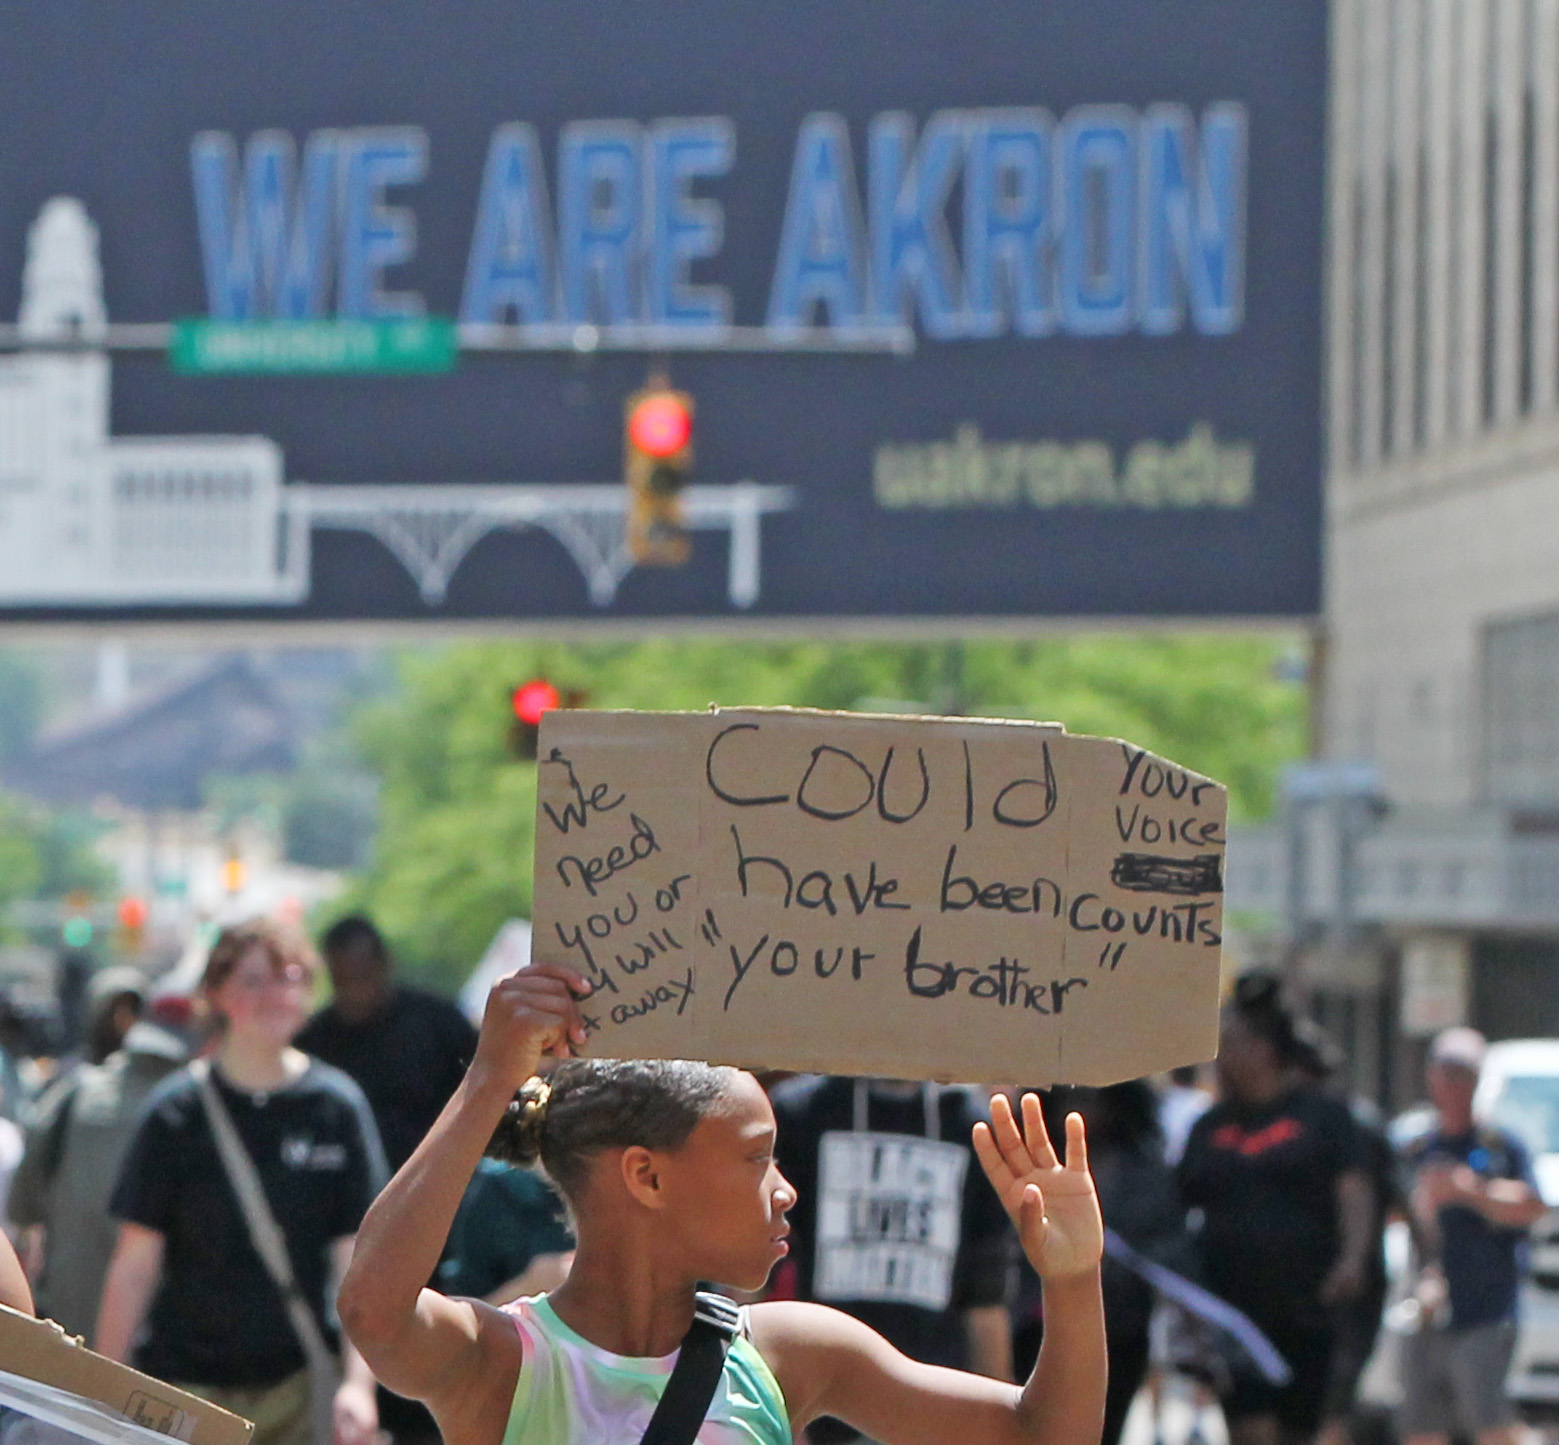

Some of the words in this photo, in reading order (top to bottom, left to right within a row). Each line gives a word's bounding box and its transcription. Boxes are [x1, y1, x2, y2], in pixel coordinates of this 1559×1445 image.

[190, 125, 428, 323] WE
[458, 116, 737, 339] ARE
[763, 100, 1250, 339] AKRON
[876, 421, 1254, 506] uakron.edu
[557, 813, 662, 897] need
[731, 824, 912, 916] have
[941, 844, 1063, 919] been
[555, 892, 639, 974] you
[655, 874, 692, 912] or
[615, 928, 684, 975] will
[611, 967, 696, 1016] away
